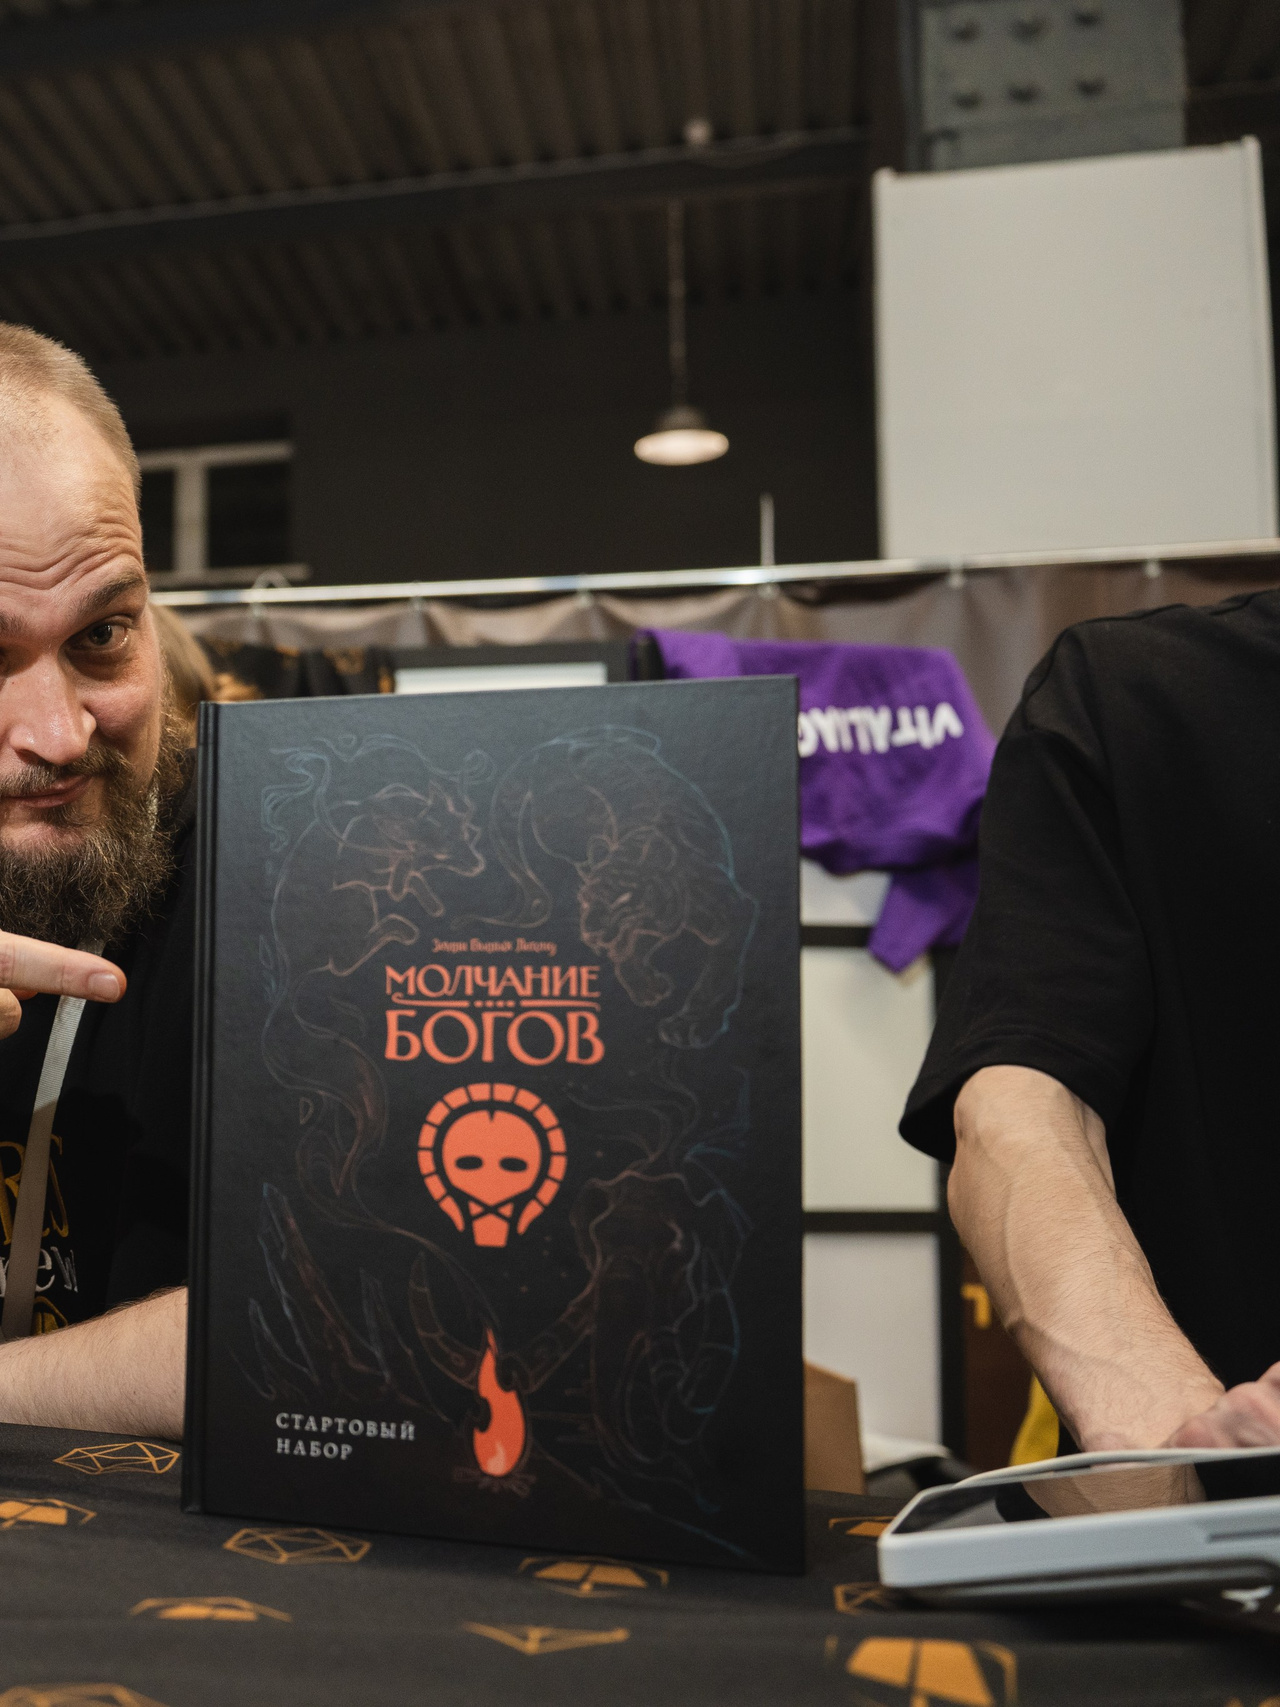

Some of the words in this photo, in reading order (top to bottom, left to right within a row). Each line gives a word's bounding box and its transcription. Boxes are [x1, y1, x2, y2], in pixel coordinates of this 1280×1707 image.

[385, 964, 601, 998] МОЛЧАНИЕ
[384, 1009, 605, 1066] БОГОВ
[275, 1412, 415, 1441] СТАРТОВЫЙ
[276, 1437, 353, 1460] НАБОР
